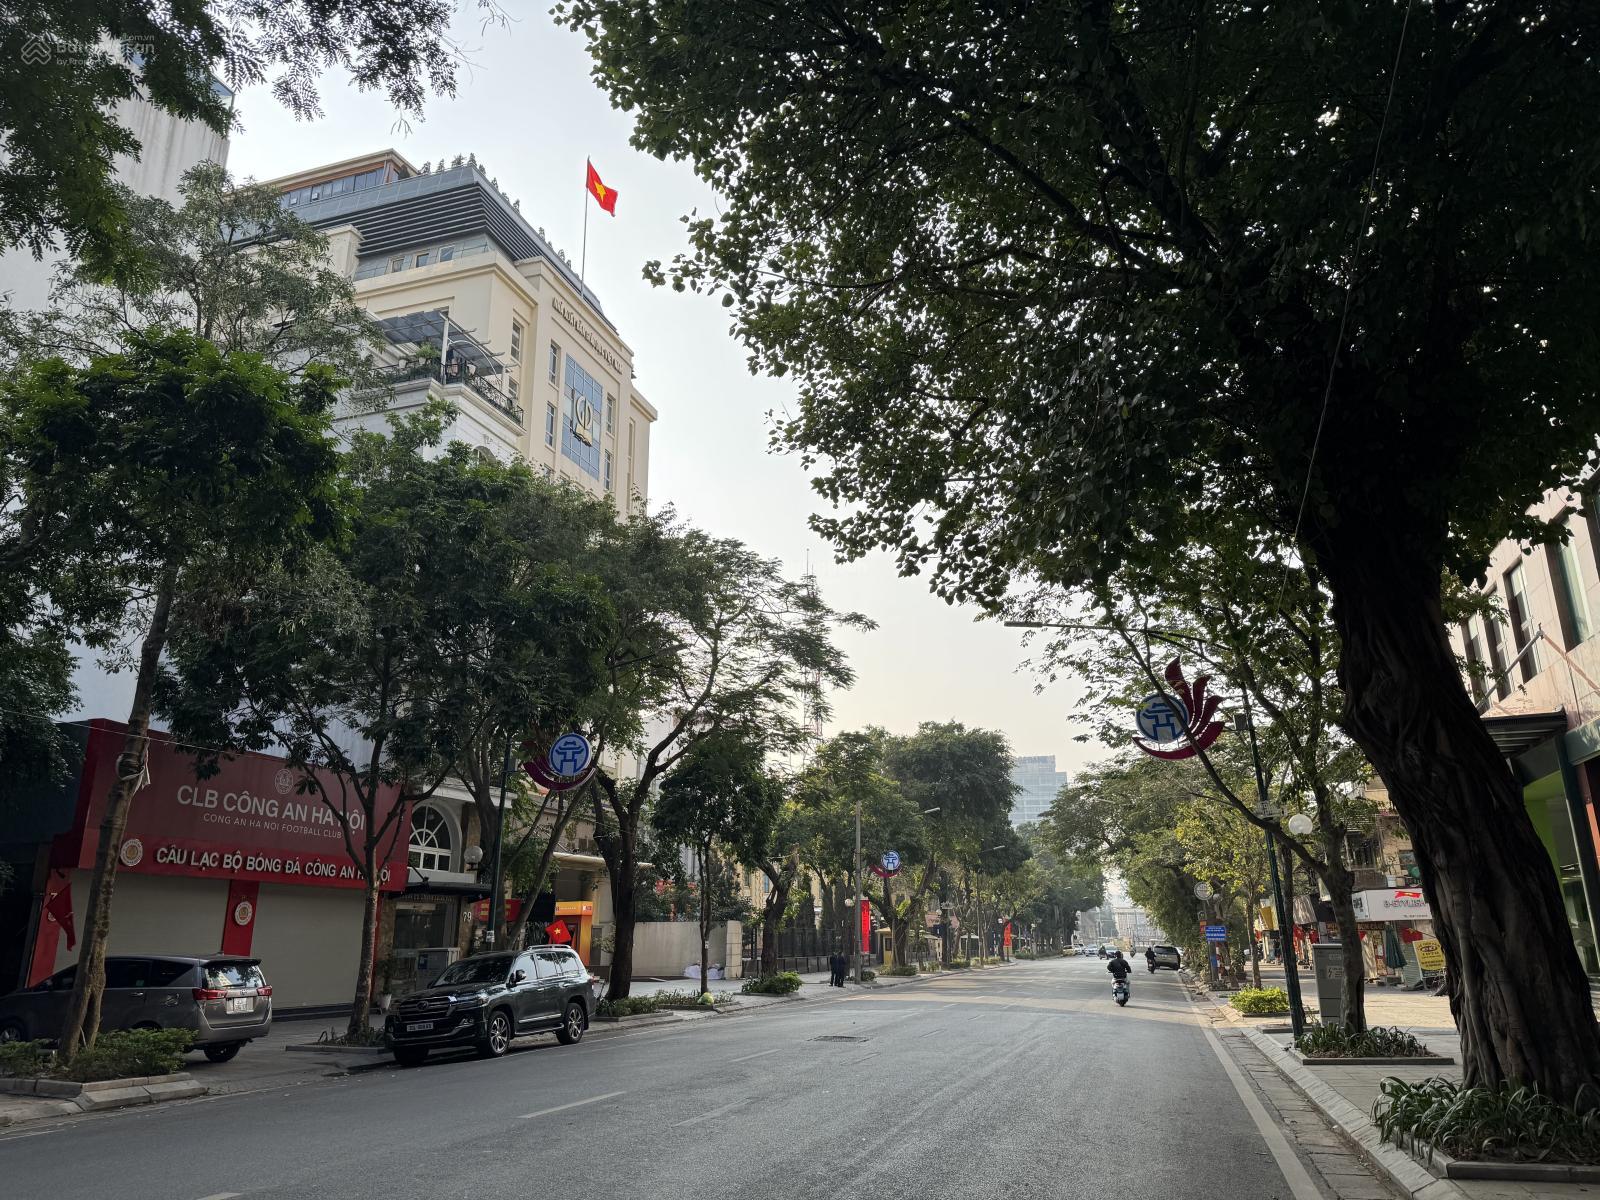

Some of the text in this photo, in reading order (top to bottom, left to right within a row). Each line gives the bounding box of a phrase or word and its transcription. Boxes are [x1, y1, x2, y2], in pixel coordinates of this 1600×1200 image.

[177, 785, 218, 809] CLB
[223, 791, 279, 817] CÔNG
[282, 802, 308, 822] AN
[203, 812, 231, 824] CONG
[234, 818, 247, 827] AN
[264, 821, 280, 831] NOI
[282, 824, 321, 836] FOOTBALL
[323, 829, 342, 839] CLUB
[156, 844, 188, 865] CÂU
[191, 850, 219, 871] LẠC
[222, 849, 243, 873] BỘ
[246, 852, 282, 873] BÓNG
[285, 857, 301, 875] ĐÁ
[305, 858, 336, 878] CÔNG
[339, 865, 355, 880] AN
